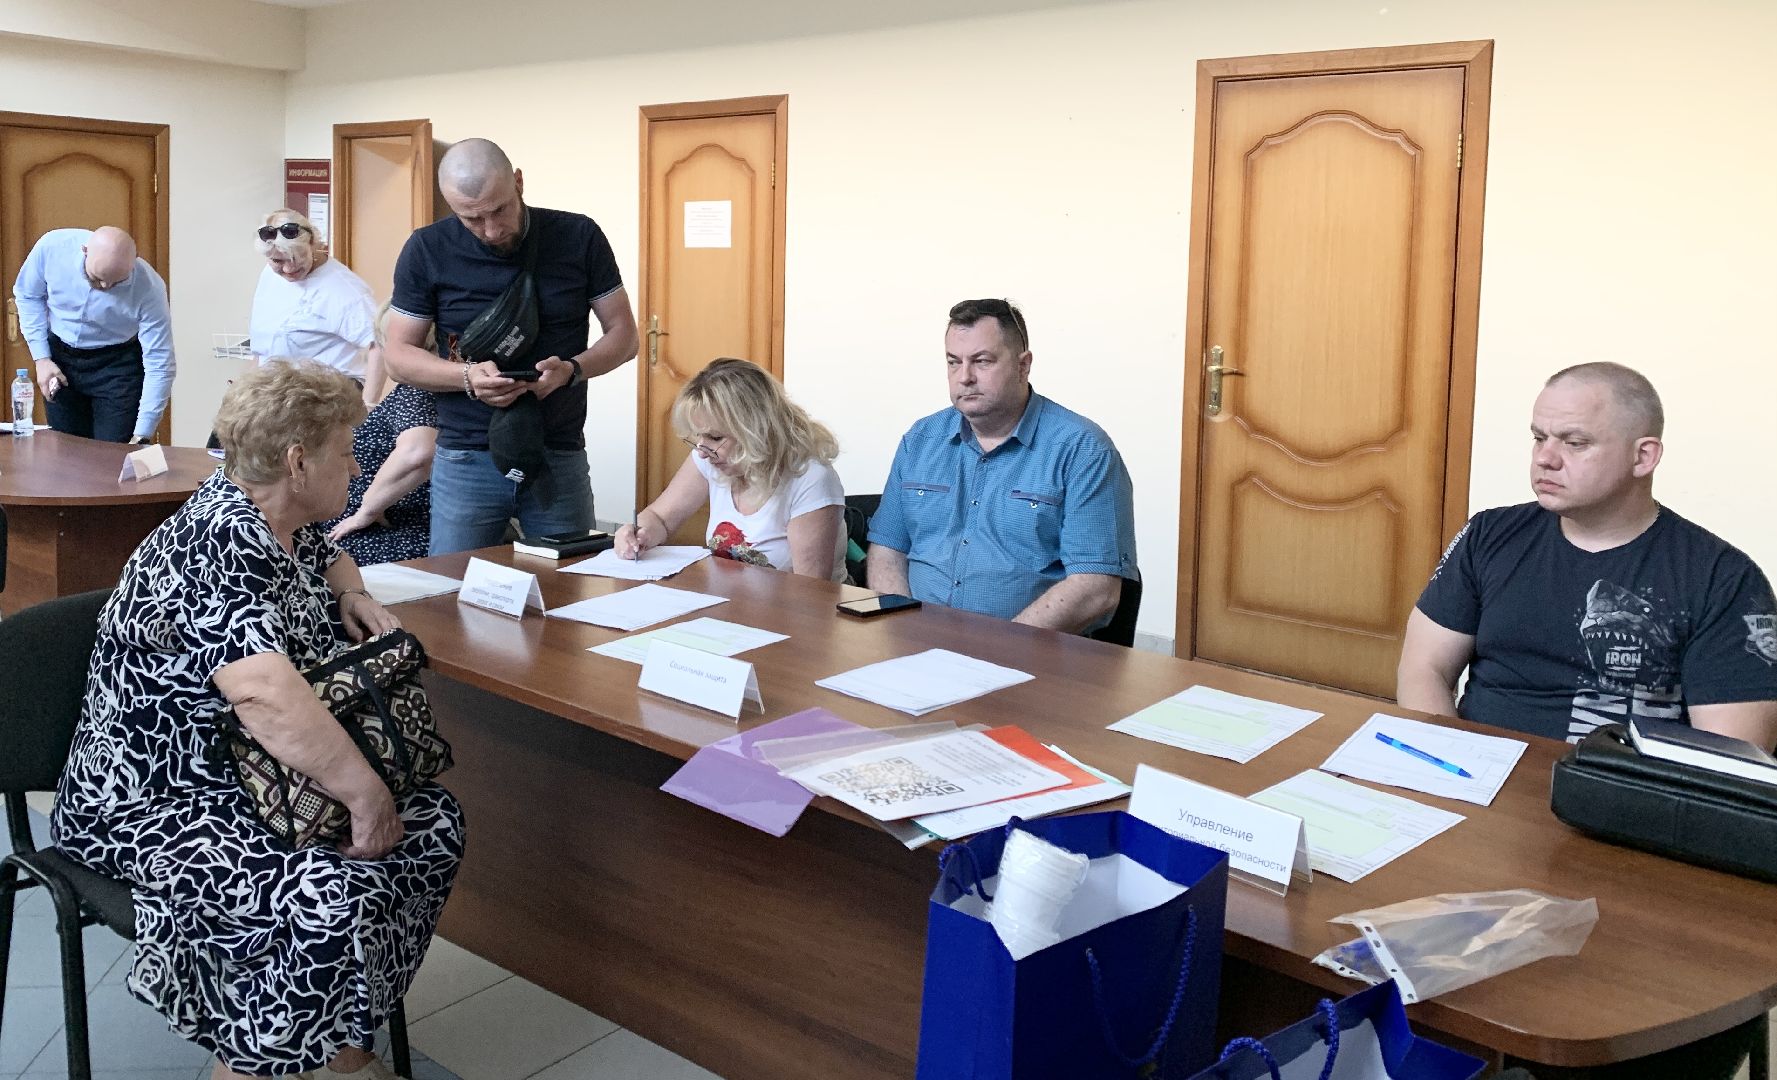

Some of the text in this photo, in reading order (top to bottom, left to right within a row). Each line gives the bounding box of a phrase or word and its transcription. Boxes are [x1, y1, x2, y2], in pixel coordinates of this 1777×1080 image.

[288, 168, 328, 177] ИНФОРМАЦИЯ
[1605, 651, 1641, 666] IRON
[1178, 808, 1254, 842] Управление
[1219, 843, 1287, 873] безопасности
